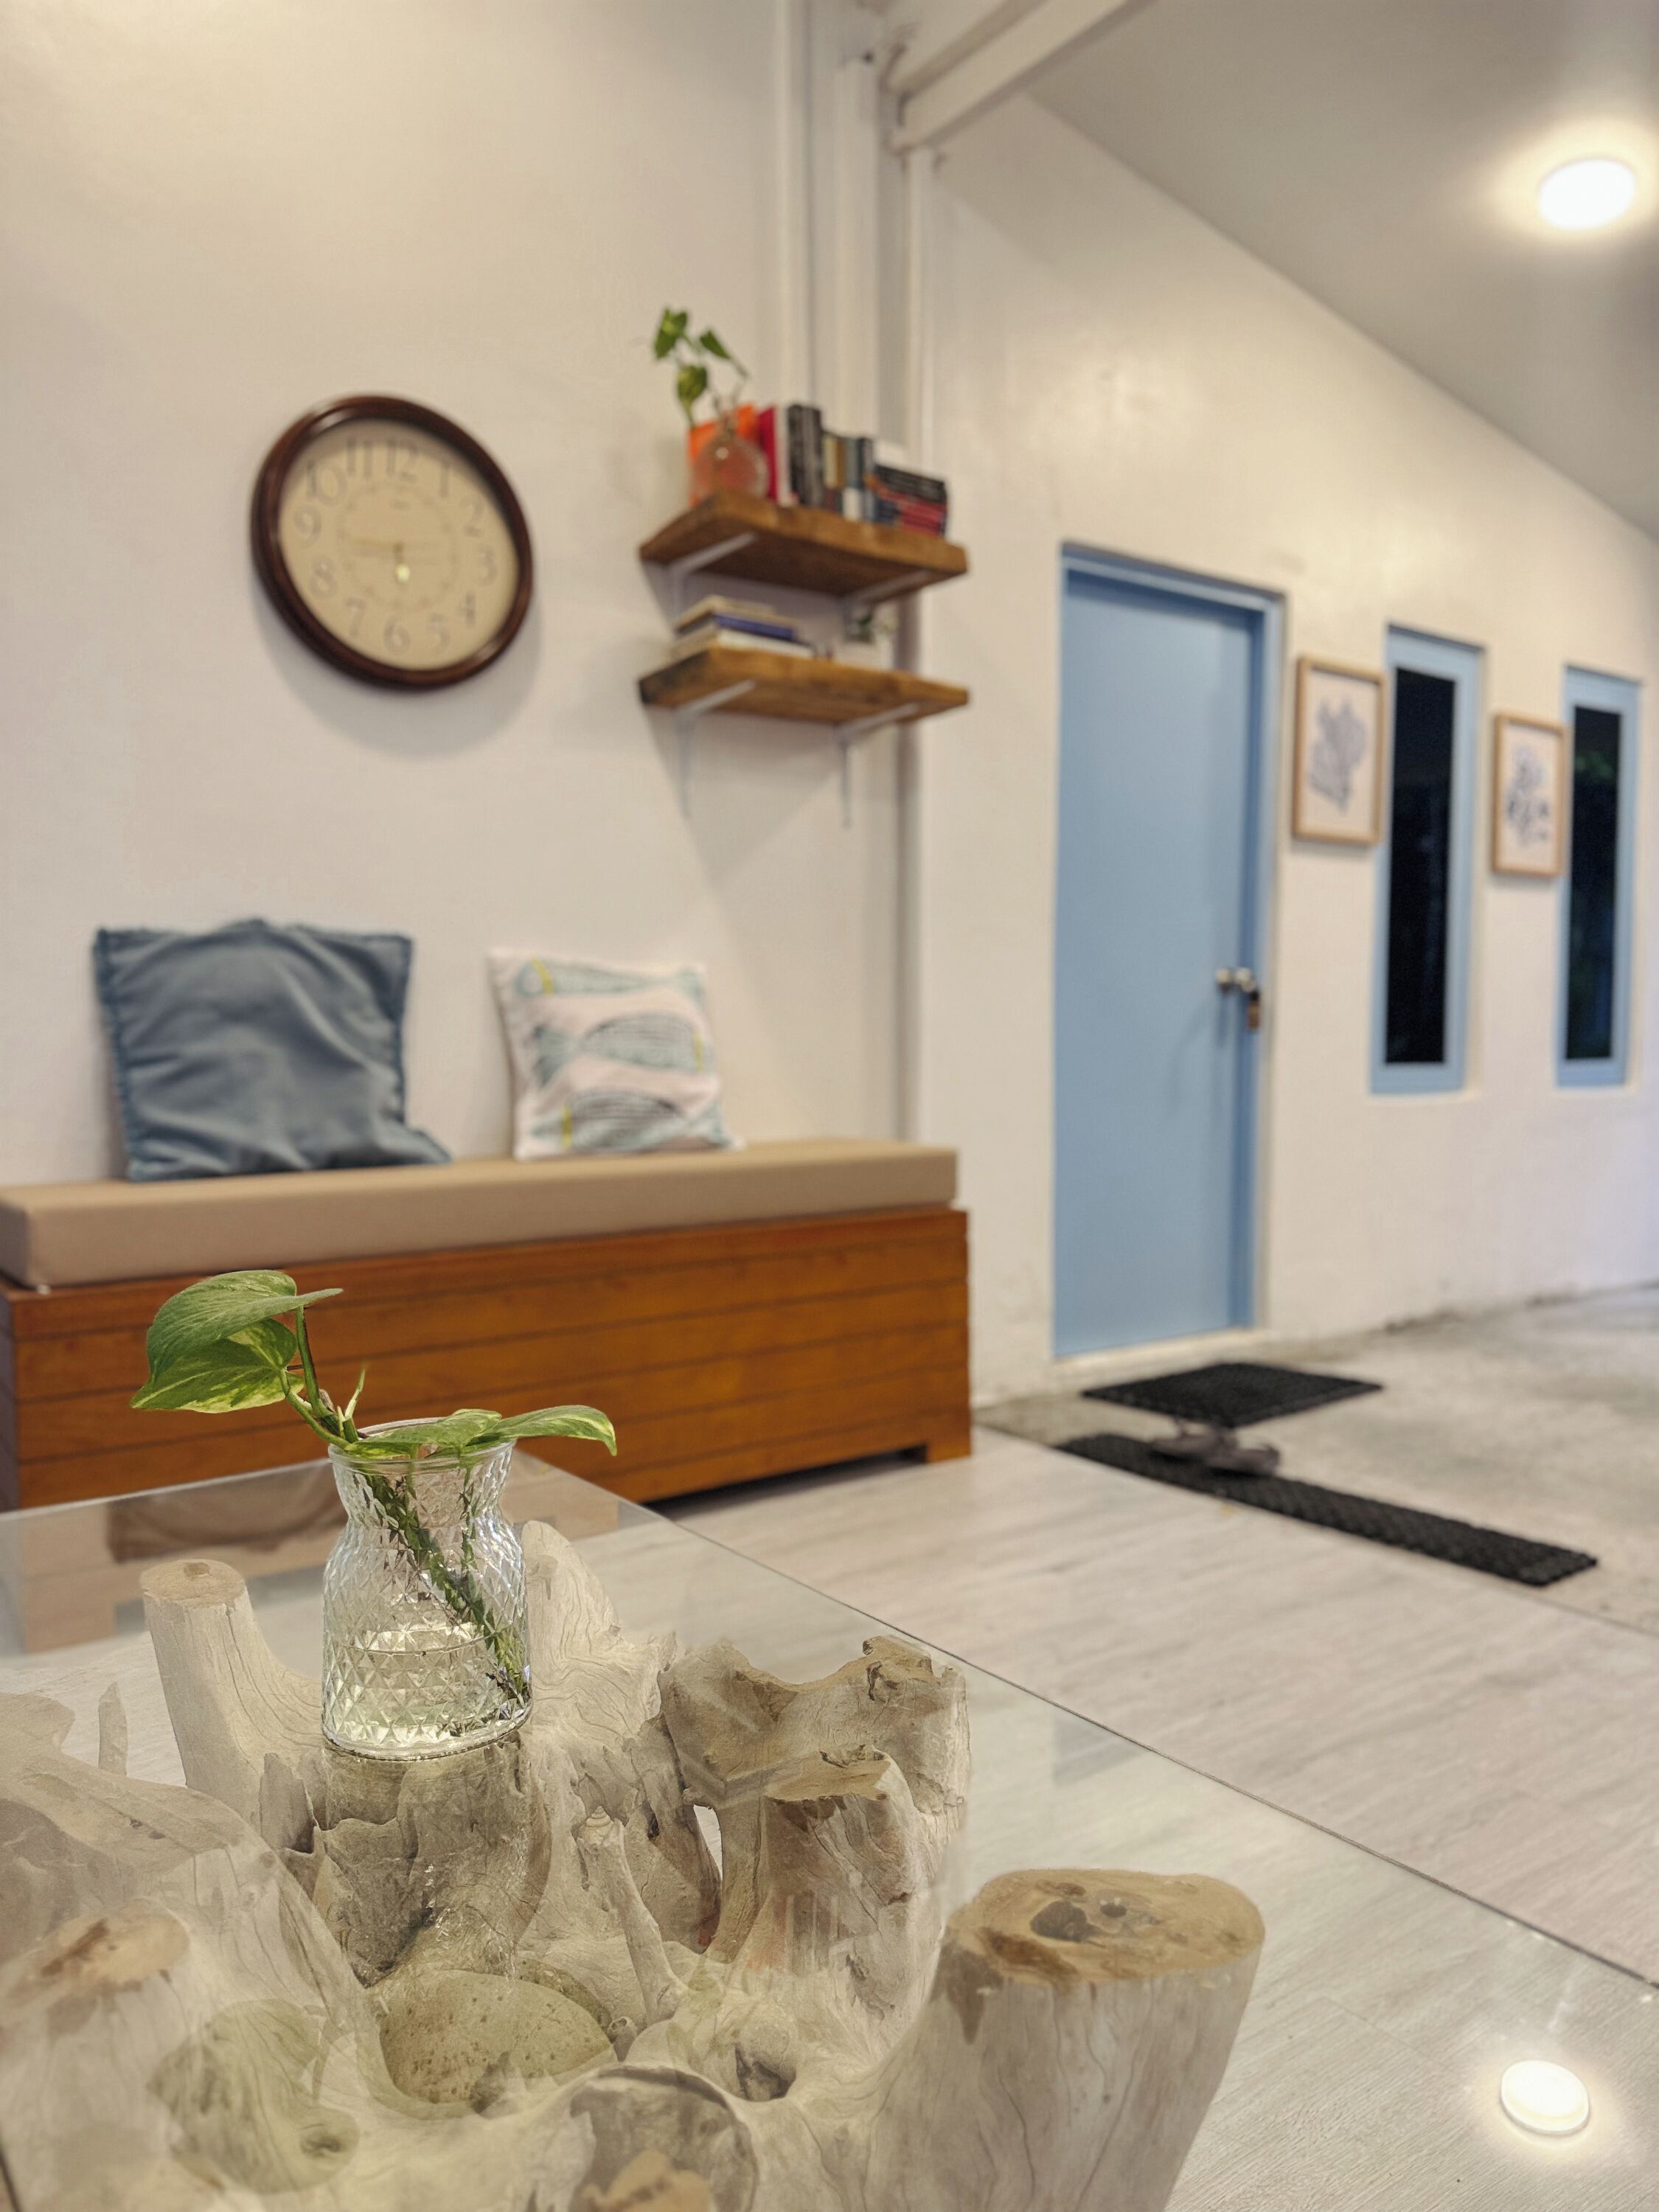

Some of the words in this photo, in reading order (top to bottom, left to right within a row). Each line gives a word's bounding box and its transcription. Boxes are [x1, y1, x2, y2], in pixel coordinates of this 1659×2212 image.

[346, 437, 372, 478] 11
[386, 439, 419, 482] 12
[307, 460, 346, 507] 10
[439, 460, 451, 498] 1
[294, 505, 321, 547] 9
[459, 495, 484, 537] 2
[310, 554, 338, 599] 8
[478, 544, 496, 586] 3
[345, 598, 366, 638] 7
[456, 591, 476, 626] 4
[384, 616, 411, 653] 6
[428, 613, 450, 652] 5
